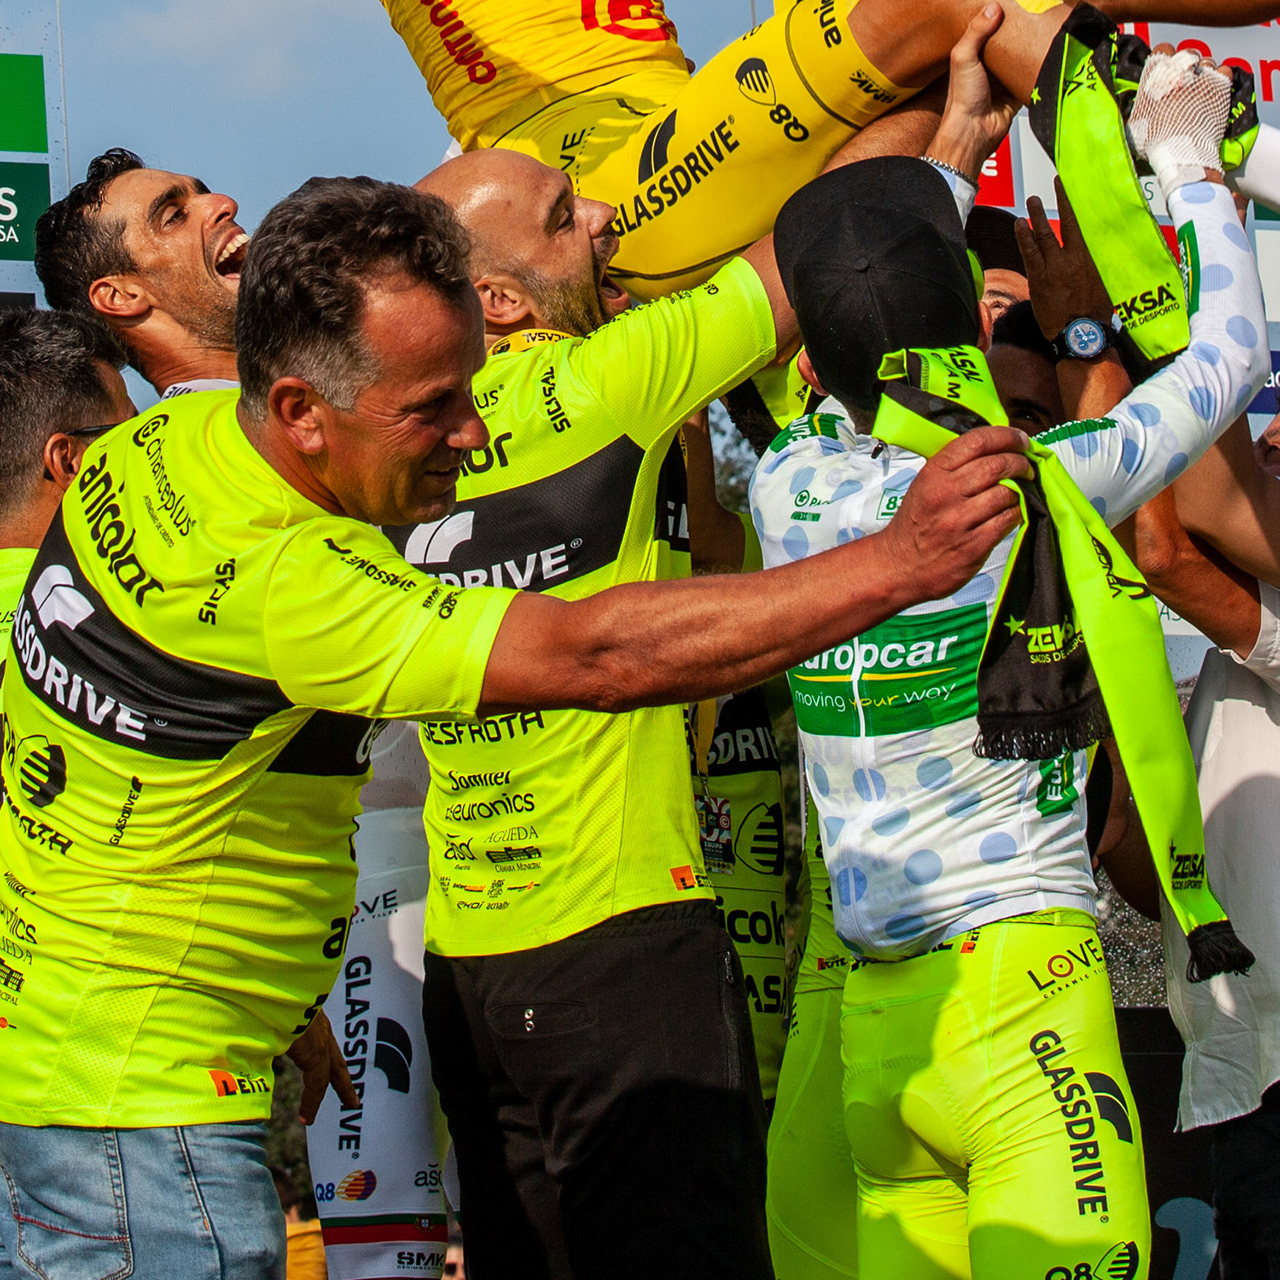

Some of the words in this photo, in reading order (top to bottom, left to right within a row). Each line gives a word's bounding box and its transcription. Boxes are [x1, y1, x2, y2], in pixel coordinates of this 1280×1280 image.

[768, 103, 810, 143] Q8
[1114, 282, 1176, 321] EKSA
[145, 435, 195, 538] chanceplus
[78, 451, 165, 608] anicolor
[11, 592, 148, 741] ASSDRIVE
[799, 634, 959, 681] uropcar
[795, 689, 846, 712] moving
[903, 683, 957, 704] way
[451, 792, 535, 822] euronics
[1027, 937, 1104, 992] LOVE
[1043, 974, 1090, 1000] CERAMIC
[1028, 1029, 1108, 1216] GLASSDRIVE
